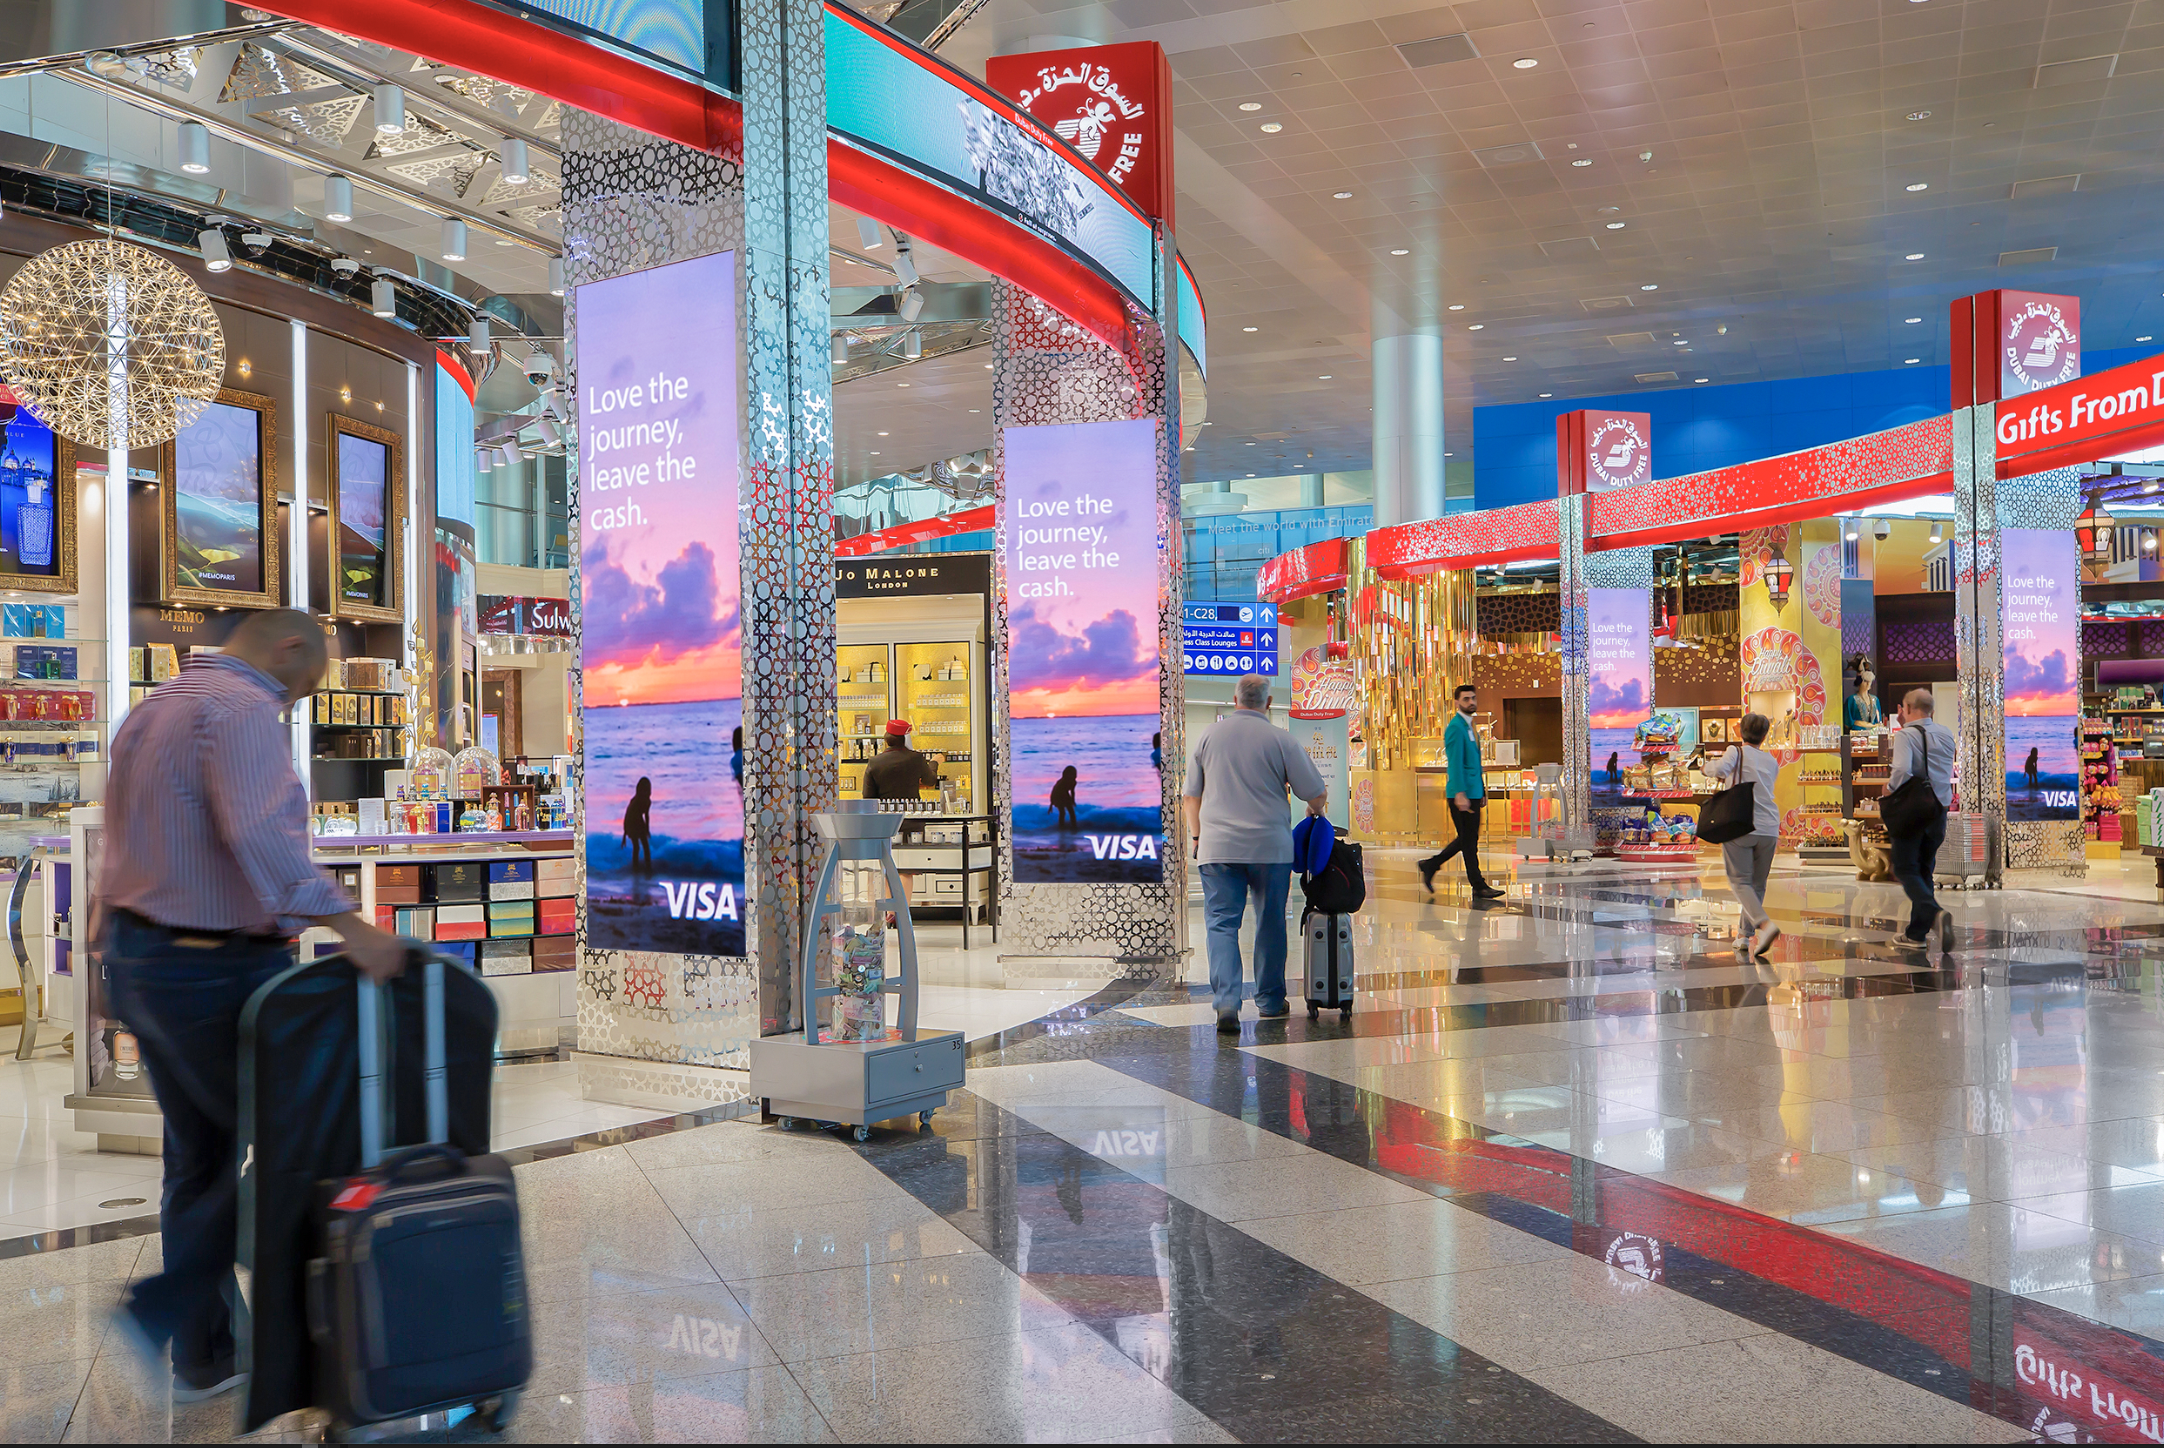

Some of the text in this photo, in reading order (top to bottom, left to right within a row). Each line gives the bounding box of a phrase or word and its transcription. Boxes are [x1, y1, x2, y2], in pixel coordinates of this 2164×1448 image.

[1014, 112, 1054, 146] Dubai Duty Free
[1108, 133, 1142, 185] FREE
[2006, 346, 2030, 386] DUBAI
[2059, 351, 2076, 383] FREE
[590, 371, 689, 415] Love the
[1997, 404, 2063, 444] Gifts
[2069, 386, 2149, 429] From
[587, 418, 683, 462] journey,
[590, 450, 696, 492] leave the
[1589, 452, 1648, 487] DUBAI DUTY FREE
[590, 496, 648, 531] cash.
[1018, 493, 1113, 518] Love the
[1208, 514, 1374, 535] Meet the world with Emirate
[1015, 524, 1108, 550] journey,
[1018, 547, 1120, 571] leave the
[198, 572, 236, 581] #MEMOPARIS
[865, 568, 939, 580] MALONE
[2007, 574, 2055, 589] Love the
[867, 582, 908, 590] LONDON
[1018, 575, 1074, 598] cash.
[2007, 592, 2053, 609] journey,
[159, 610, 205, 624] MEMO
[531, 606, 571, 630] Sulw
[2008, 608, 2058, 622] leave the
[172, 624, 194, 633] PARIS
[1592, 622, 1633, 633] Love the
[2008, 625, 2036, 639] cash.
[1211, 639, 1238, 648] Lounges
[1592, 635, 1630, 648] journey,
[1593, 647, 1636, 659] leave the
[1593, 660, 1617, 671] cash.
[1751, 654, 1791, 676] Diwali
[1320, 678, 1355, 696] Happy
[2041, 791, 2077, 808] VISA
[1083, 834, 1158, 861] VISA
[658, 882, 738, 923] VISA
[952, 1040, 961, 1051] 35
